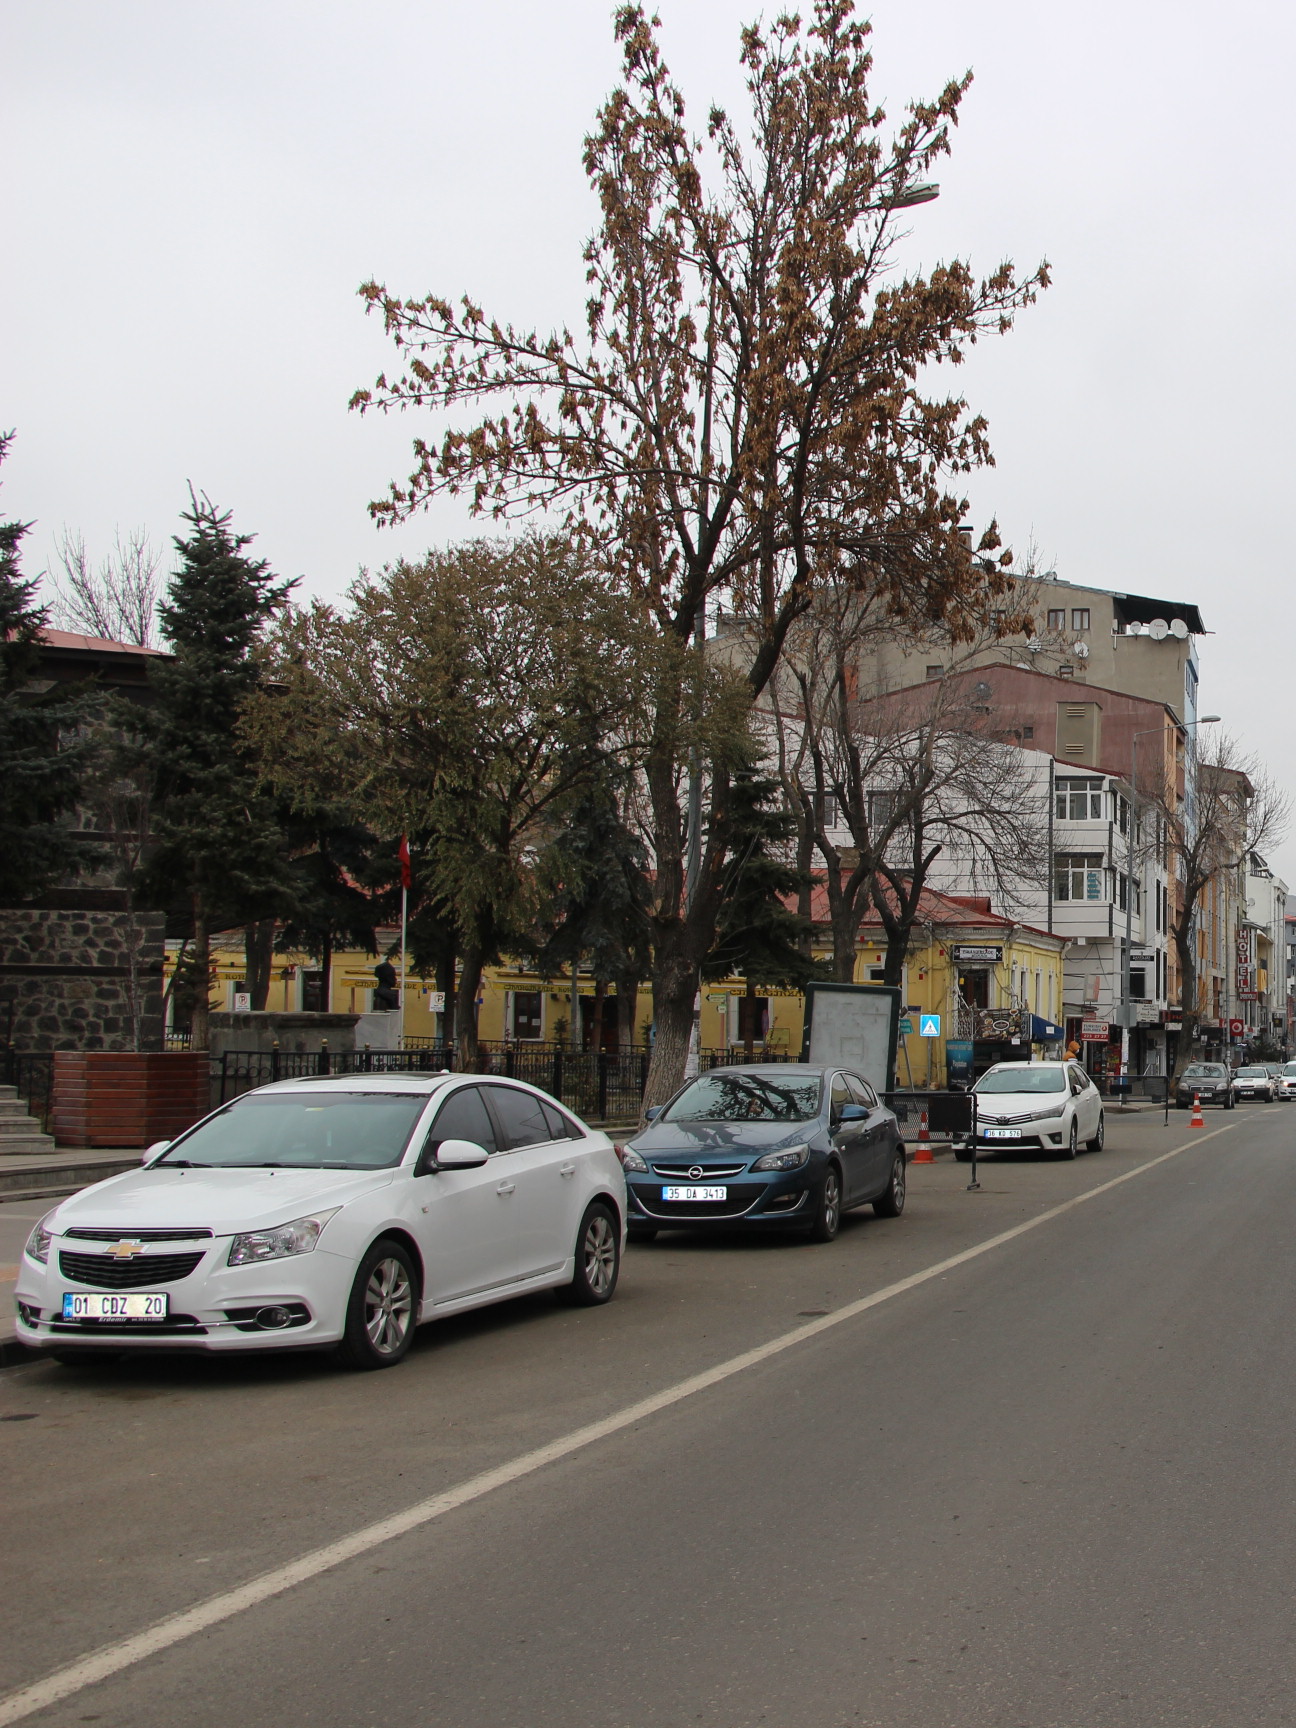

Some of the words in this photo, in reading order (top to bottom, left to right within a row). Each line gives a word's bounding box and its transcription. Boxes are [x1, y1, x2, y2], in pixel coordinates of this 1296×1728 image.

[1239, 930, 1249, 988] HOTEL
[668, 1188, 680, 1199] 35
[686, 1188, 698, 1199] DA
[703, 1188, 725, 1199] 3413
[74, 1297, 89, 1315] 01
[102, 1297, 128, 1315] CDZ
[144, 1297, 162, 1315] 20
